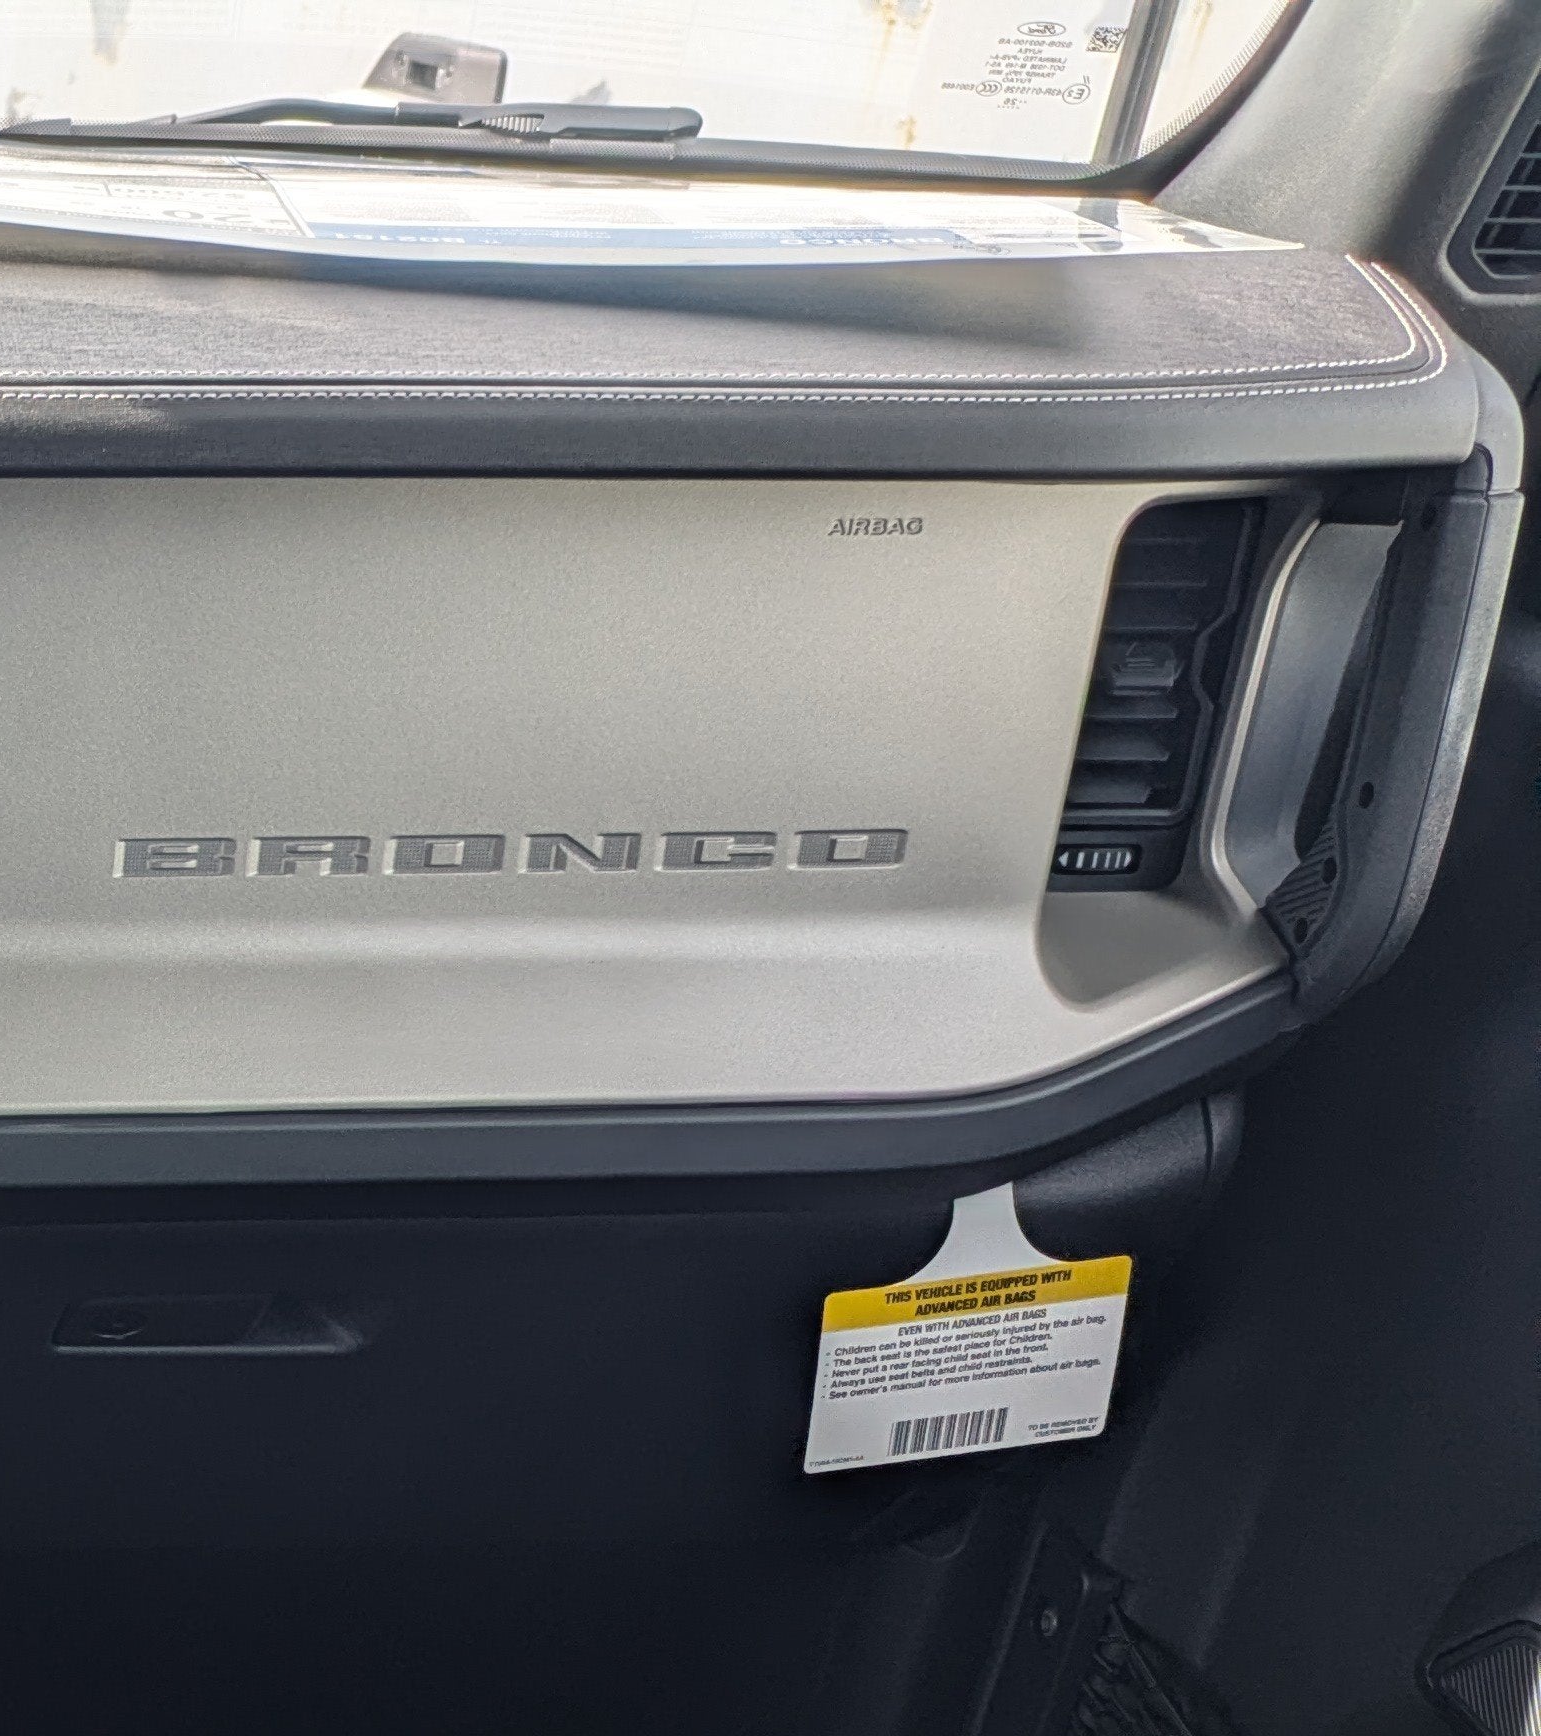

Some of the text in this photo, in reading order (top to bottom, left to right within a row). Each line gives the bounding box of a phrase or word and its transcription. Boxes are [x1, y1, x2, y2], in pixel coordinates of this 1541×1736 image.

[828, 516, 924, 537] AIRBAG
[114, 827, 910, 878] BRONCO
[885, 1269, 1072, 1304] THIS VEHICLE IS EQUIPPED WITH
[915, 1290, 1036, 1316] ADVANCED AIR BAGS
[898, 1308, 1047, 1337] EVEN WITH ADVANCED AIR BAGS
[834, 1343, 876, 1357] Children
[878, 1343, 896, 1351] can
[899, 1339, 911, 1348] be
[914, 1335, 940, 1346] killed
[955, 1329, 999, 1342] seriously
[1002, 1322, 1036, 1335] injured
[1038, 1321, 1050, 1331] by
[1053, 1319, 1068, 1328] the
[834, 1359, 851, 1367] The
[854, 1355, 877, 1365] back
[880, 1352, 901, 1361] seat
[915, 1348, 930, 1357] the
[932, 1344, 961, 1354] safest
[964, 1340, 990, 1353] place
[993, 1338, 1006, 1347] for
